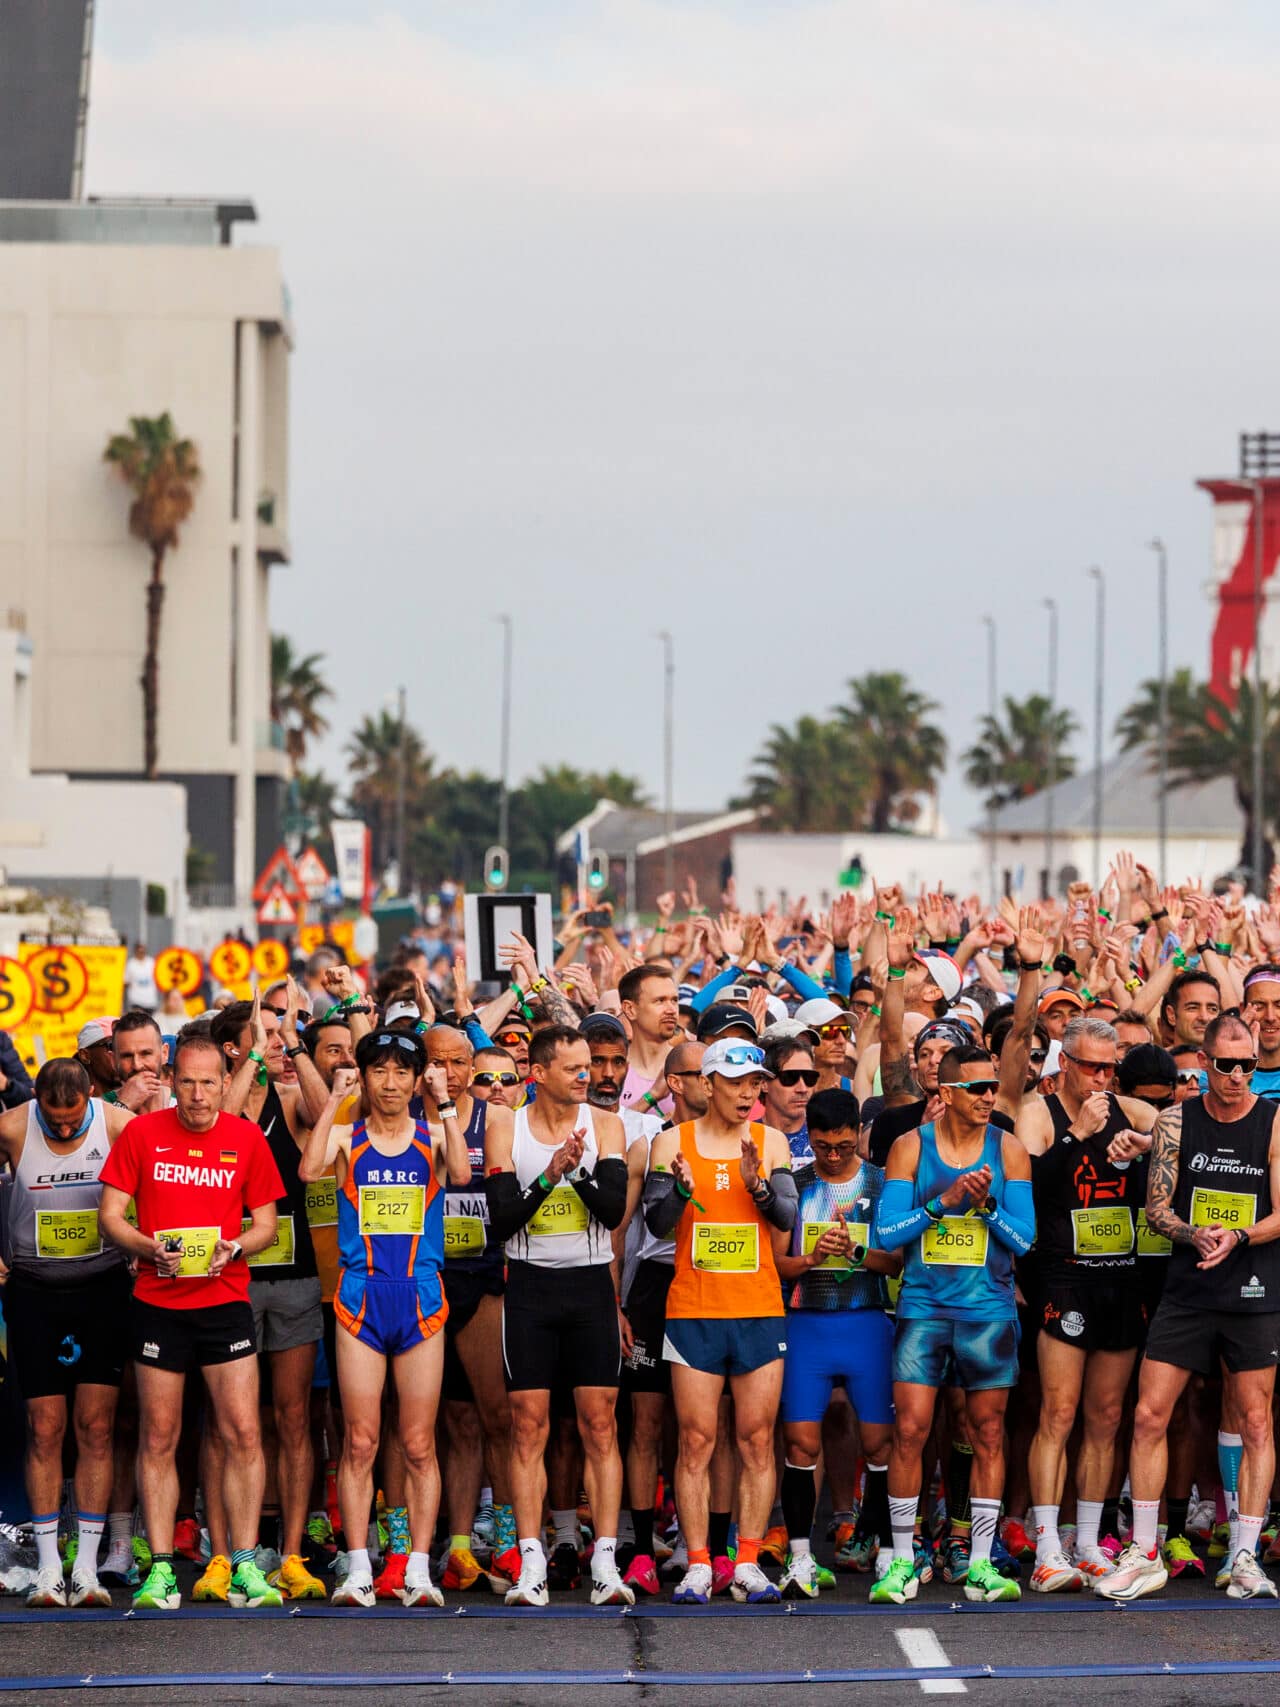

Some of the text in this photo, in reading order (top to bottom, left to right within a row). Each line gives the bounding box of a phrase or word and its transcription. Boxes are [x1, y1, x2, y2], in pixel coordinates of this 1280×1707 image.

[43, 962, 70, 998] S
[1211, 1156, 1241, 1166] Groupe
[153, 1161, 236, 1189] GERMANY
[1206, 1163, 1264, 1176] armorine
[36, 1171, 94, 1184] CUBE
[305, 1193, 335, 1208] 685
[377, 1203, 409, 1215] 2127
[542, 1202, 572, 1217] 2131
[1206, 1207, 1239, 1222] 1848
[52, 1227, 86, 1240] 1362
[1090, 1224, 1121, 1236] 1680
[443, 1232, 470, 1245] 514
[936, 1233, 974, 1246] 2063
[708, 1241, 745, 1253] 2807
